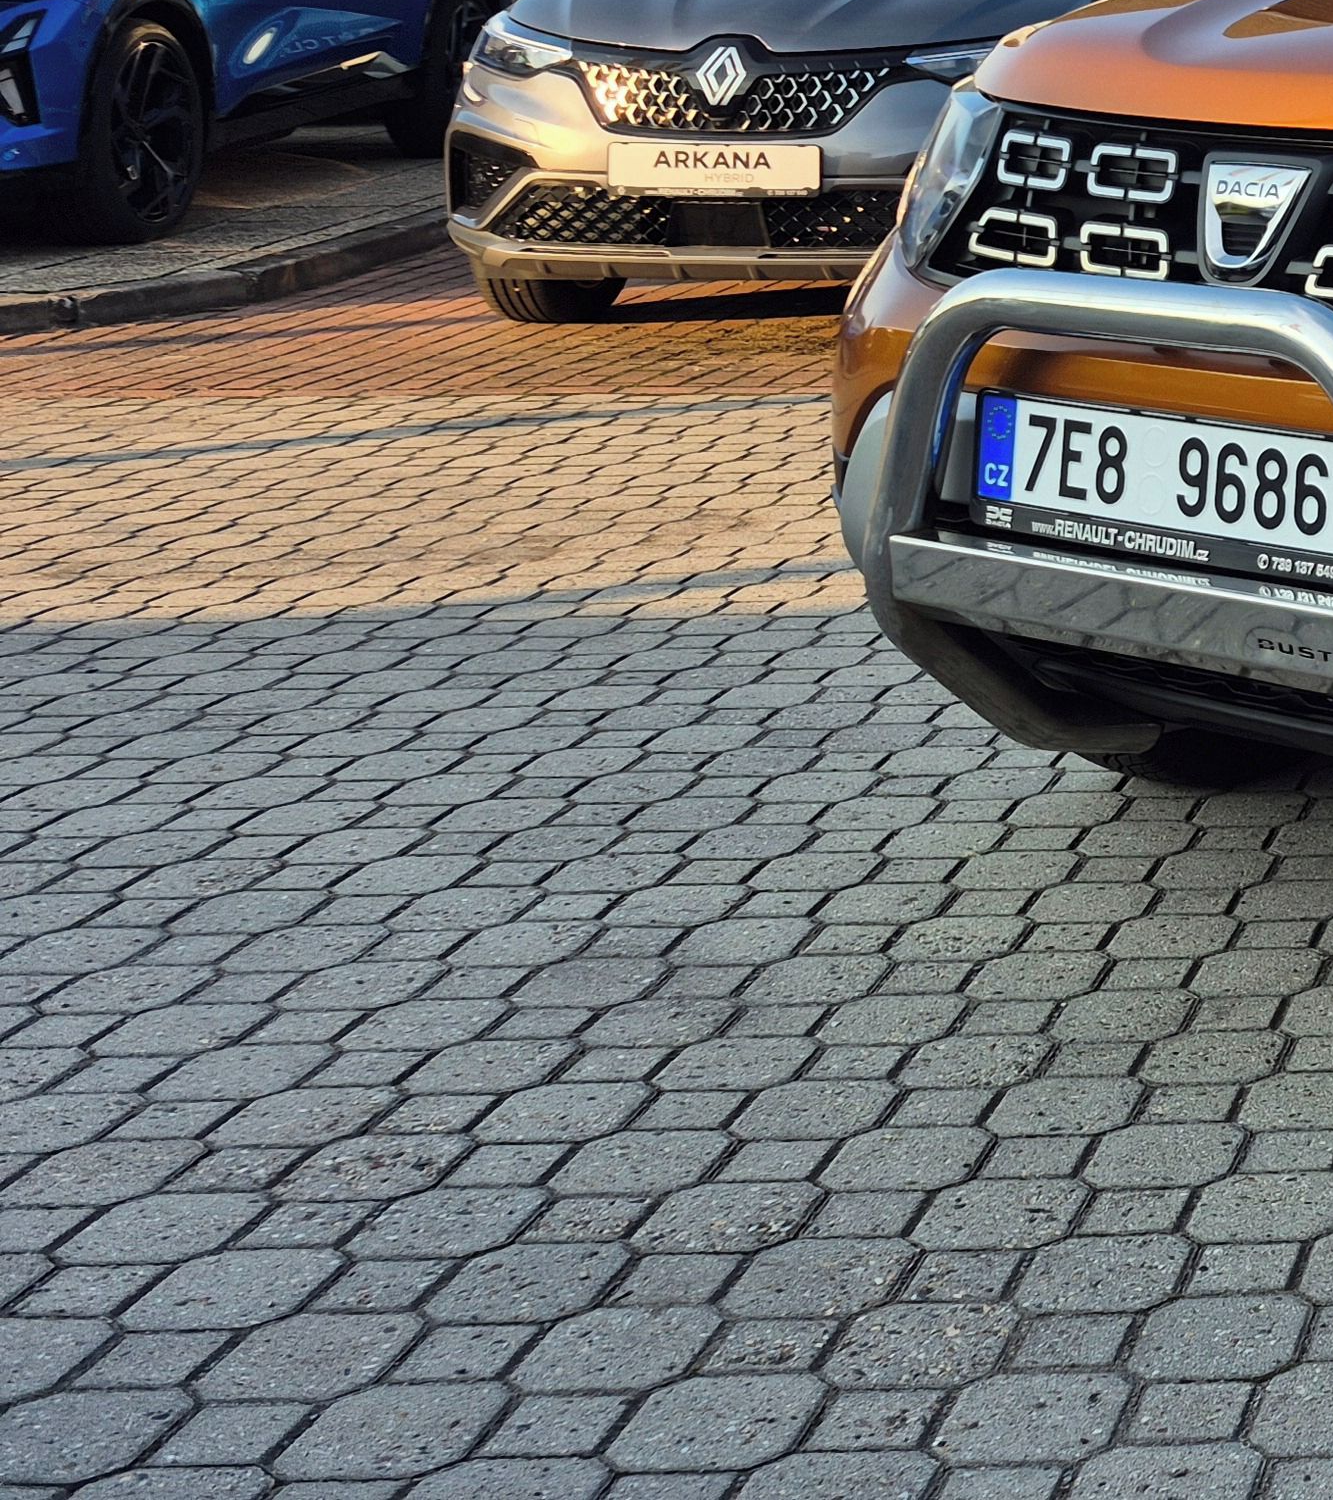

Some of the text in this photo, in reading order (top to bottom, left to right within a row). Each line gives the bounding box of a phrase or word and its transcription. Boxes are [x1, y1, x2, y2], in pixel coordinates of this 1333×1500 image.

[653, 150, 771, 169] ARKANA
[704, 173, 755, 183] HYBRID
[1216, 180, 1279, 199] DACIA
[984, 462, 1010, 488] CZ
[1024, 413, 1330, 536] 7E8 9686
